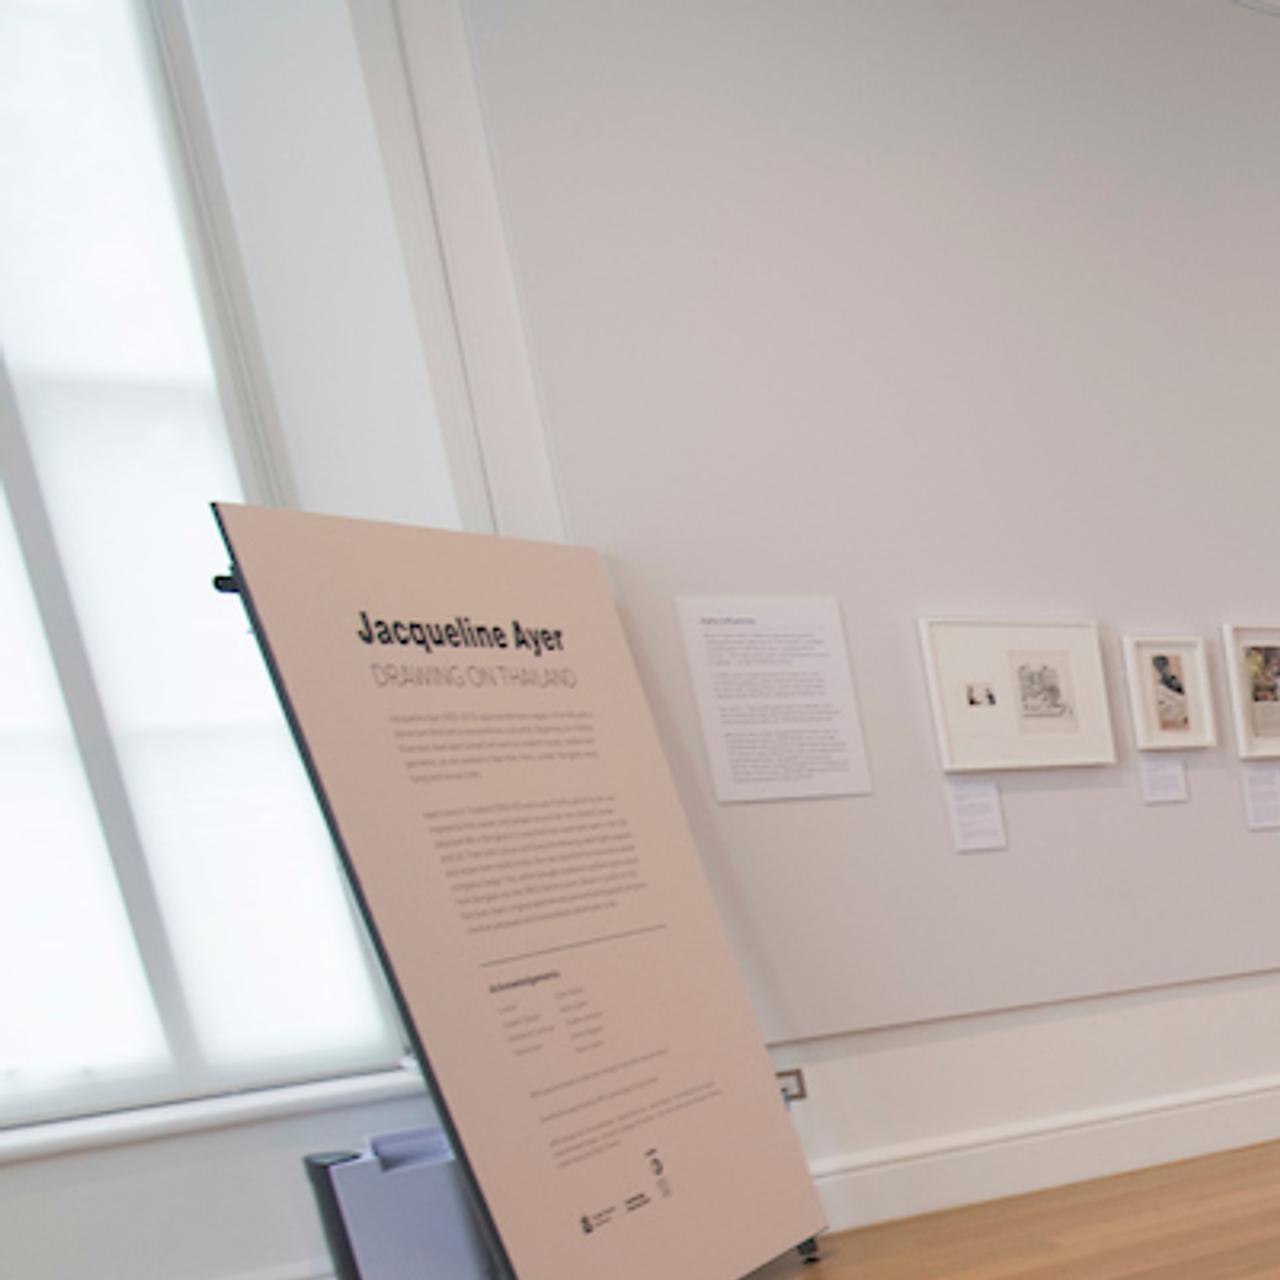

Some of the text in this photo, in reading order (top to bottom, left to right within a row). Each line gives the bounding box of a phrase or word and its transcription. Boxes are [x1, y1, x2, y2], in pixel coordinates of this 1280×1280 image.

[357, 610, 564, 657] Jacqueline Ayer
[370, 661, 578, 690] DRAWING ON THAILAND
